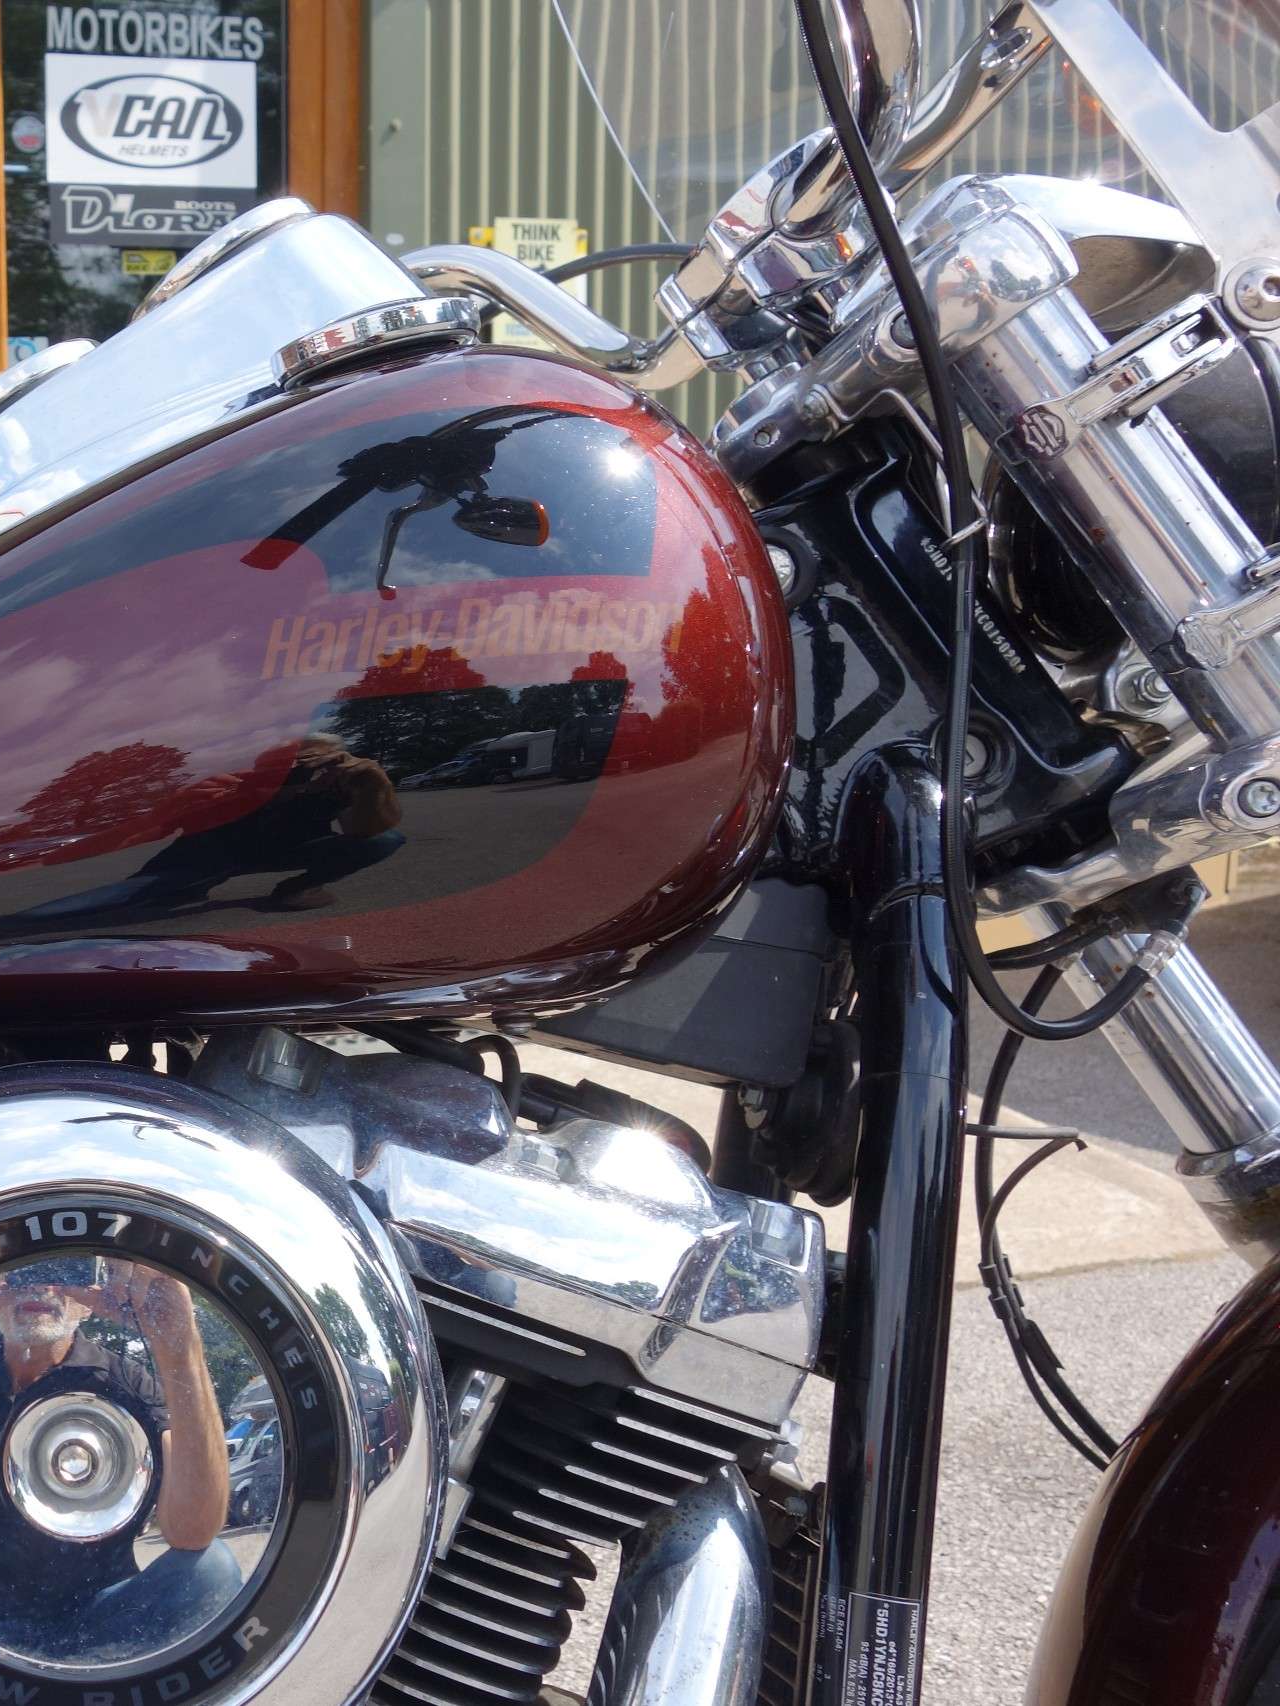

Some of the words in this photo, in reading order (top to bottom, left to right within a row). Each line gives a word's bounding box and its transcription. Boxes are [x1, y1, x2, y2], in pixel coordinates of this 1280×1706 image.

[46, 6, 264, 60] MOTORBIKES
[119, 143, 189, 158] HELMETS
[511, 223, 561, 241] THINK
[518, 244, 554, 261] BIKE
[261, 588, 683, 681] Harley-Davidson
[24, 1211, 132, 1241] 107
[160, 1232, 319, 1410] INCHES
[83, 1616, 270, 1706] RIDER
